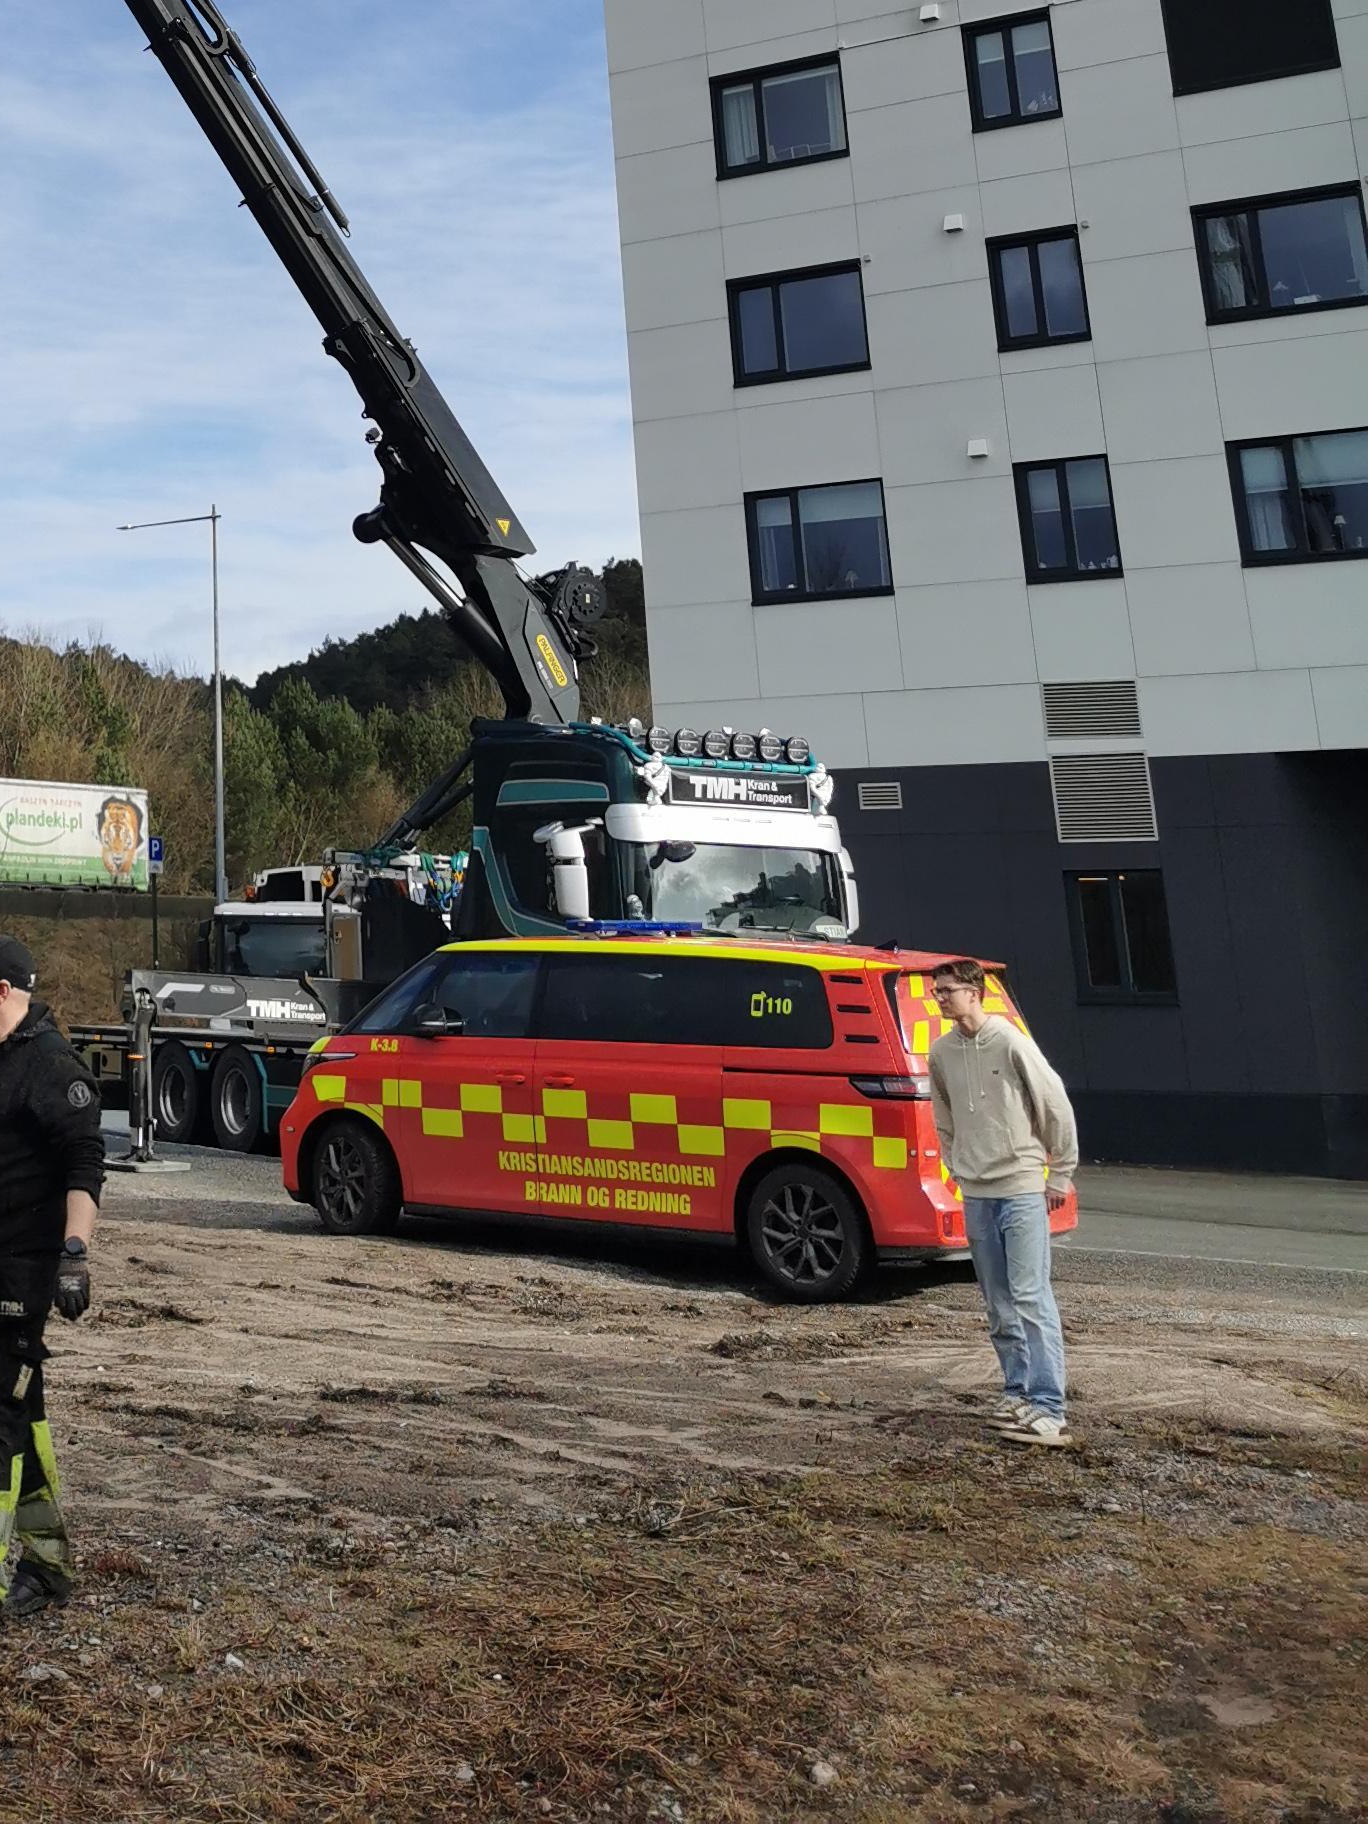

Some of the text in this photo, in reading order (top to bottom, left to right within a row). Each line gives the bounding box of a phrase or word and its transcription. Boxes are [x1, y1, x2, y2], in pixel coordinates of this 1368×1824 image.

[538, 637, 565, 684] PALFINGER
[689, 775, 748, 801] TMH
[748, 779, 778, 792] Kran &
[747, 790, 793, 805] Transport
[5, 807, 83, 833] plandeki.pl
[151, 839, 160, 858] P
[246, 999, 291, 1018] TMH
[291, 1001, 309, 1011] Kran
[766, 997, 792, 1015] 110
[291, 1010, 326, 1022] Transport
[370, 1037, 399, 1053] K-3.8
[498, 1150, 716, 1188] KRISTIANSANDSREGIONEN
[525, 1180, 692, 1216] BRANN OG REDNING
